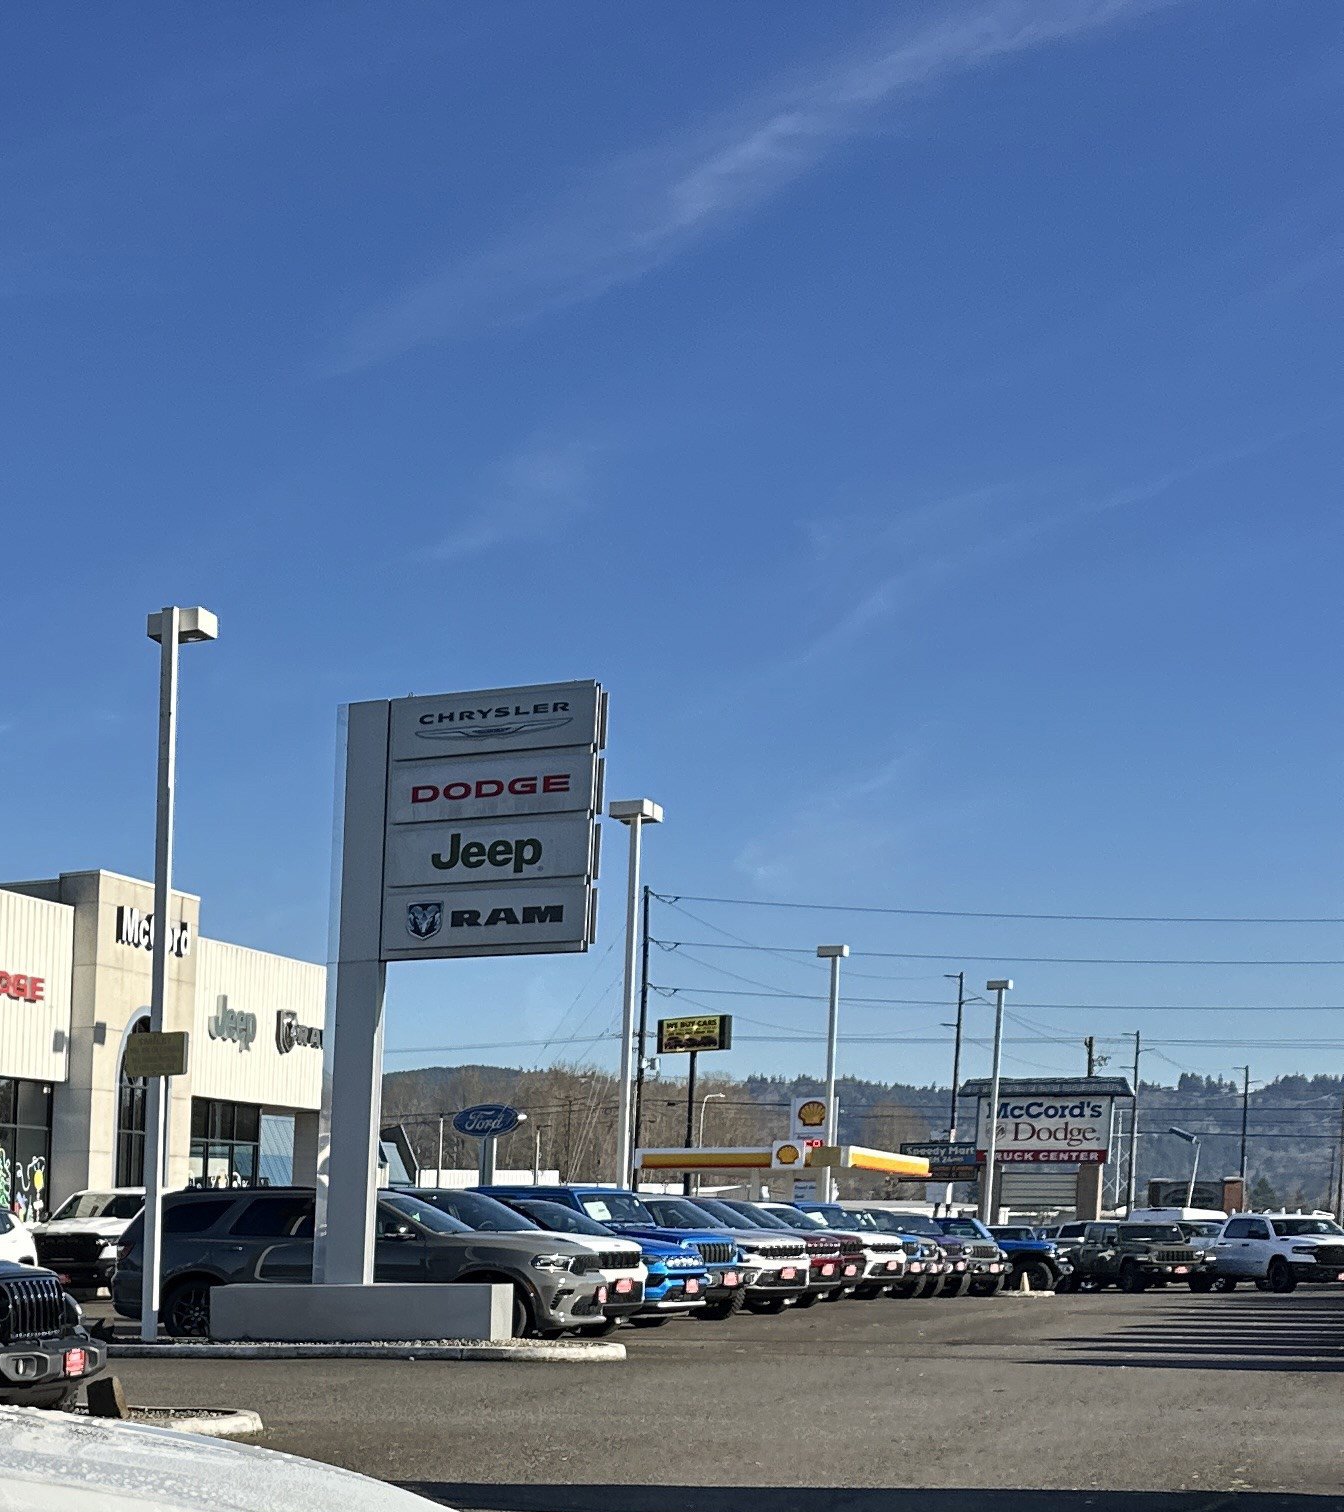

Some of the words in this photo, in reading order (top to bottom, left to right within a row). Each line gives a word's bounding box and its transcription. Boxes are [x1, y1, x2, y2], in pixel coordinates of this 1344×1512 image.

[419, 702, 570, 725] CHRYSLER
[411, 774, 571, 804] DODGE
[431, 833, 543, 873] Jeep
[450, 904, 564, 928] RAM
[115, 905, 192, 958] Mcrd
[208, 994, 257, 1053] Jeep
[296, 1024, 324, 1050] RA
[465, 1110, 505, 1131] Ford
[1039, 1152, 1099, 1161] CENTER
